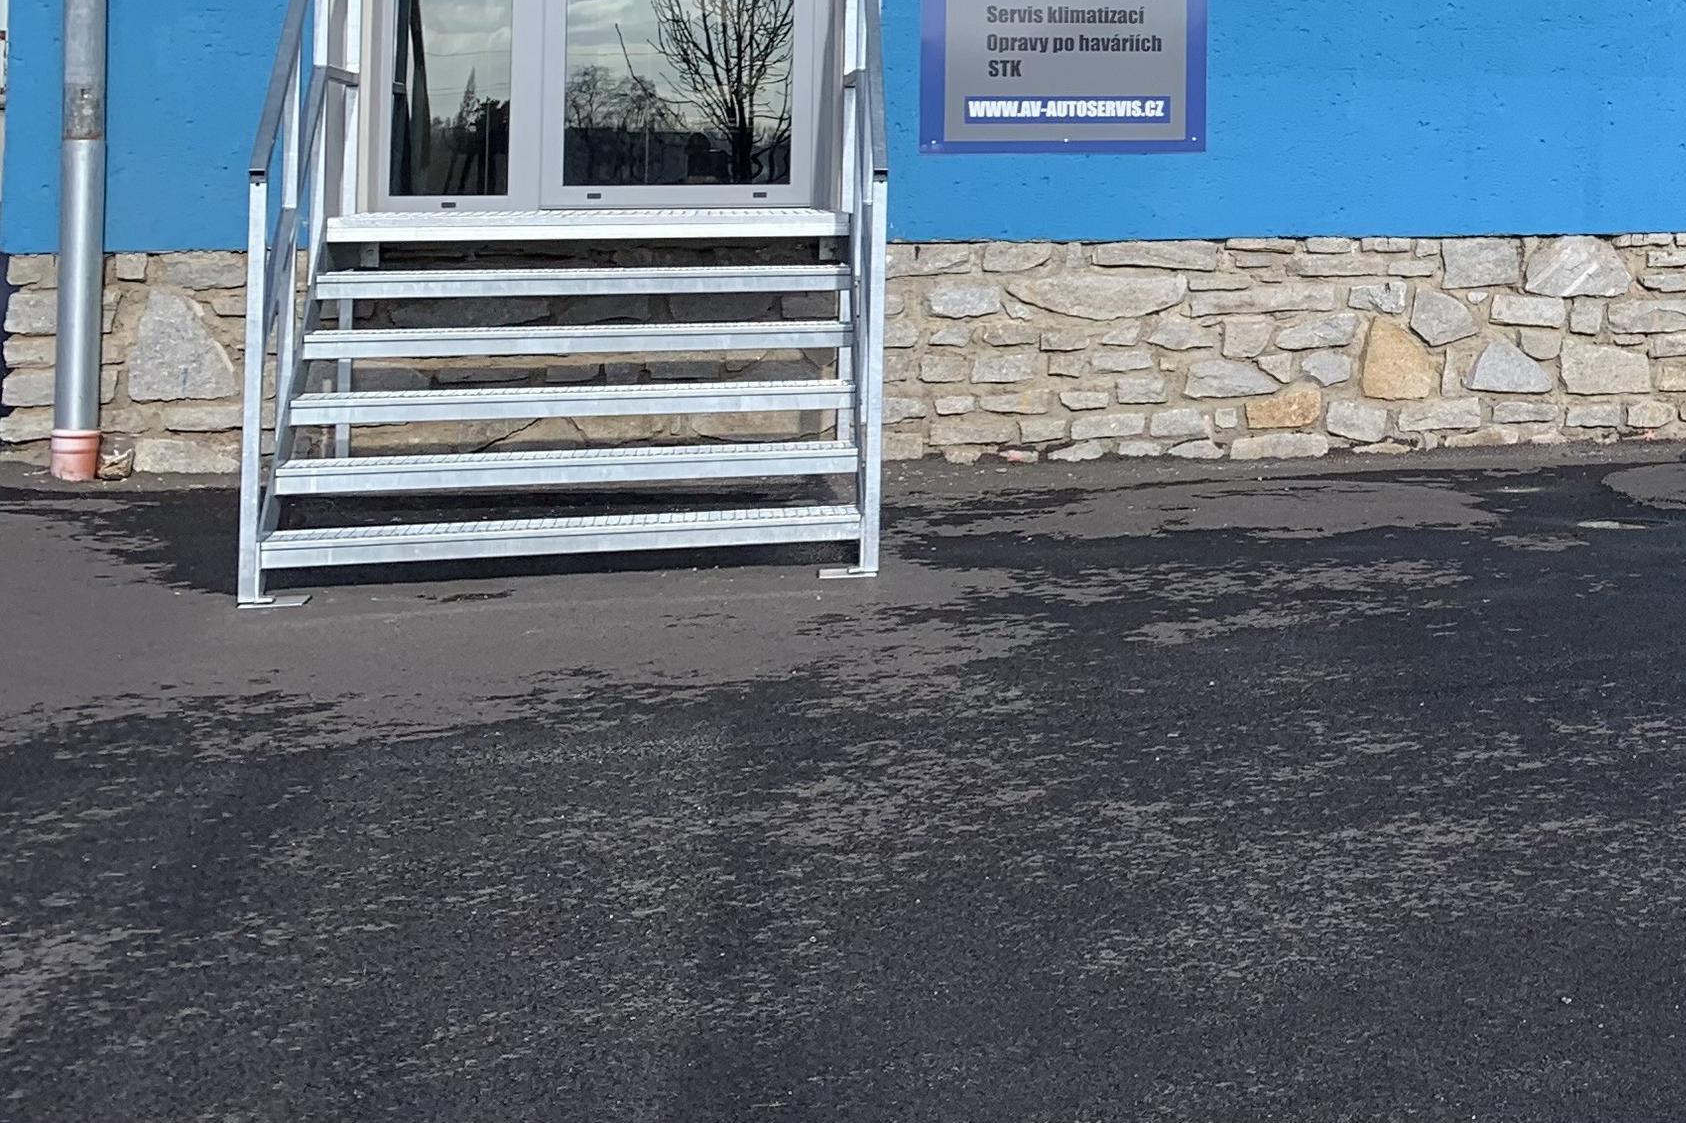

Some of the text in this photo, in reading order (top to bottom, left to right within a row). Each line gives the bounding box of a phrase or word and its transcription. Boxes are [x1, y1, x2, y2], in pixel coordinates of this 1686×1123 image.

[986, 5, 1145, 25] Servis klimatizací
[986, 33, 1163, 54] Opravy po haváriích
[988, 59, 1022, 78] STK
[967, 99, 1165, 118] WWW.AV-AUTOSERVIS.CZ
